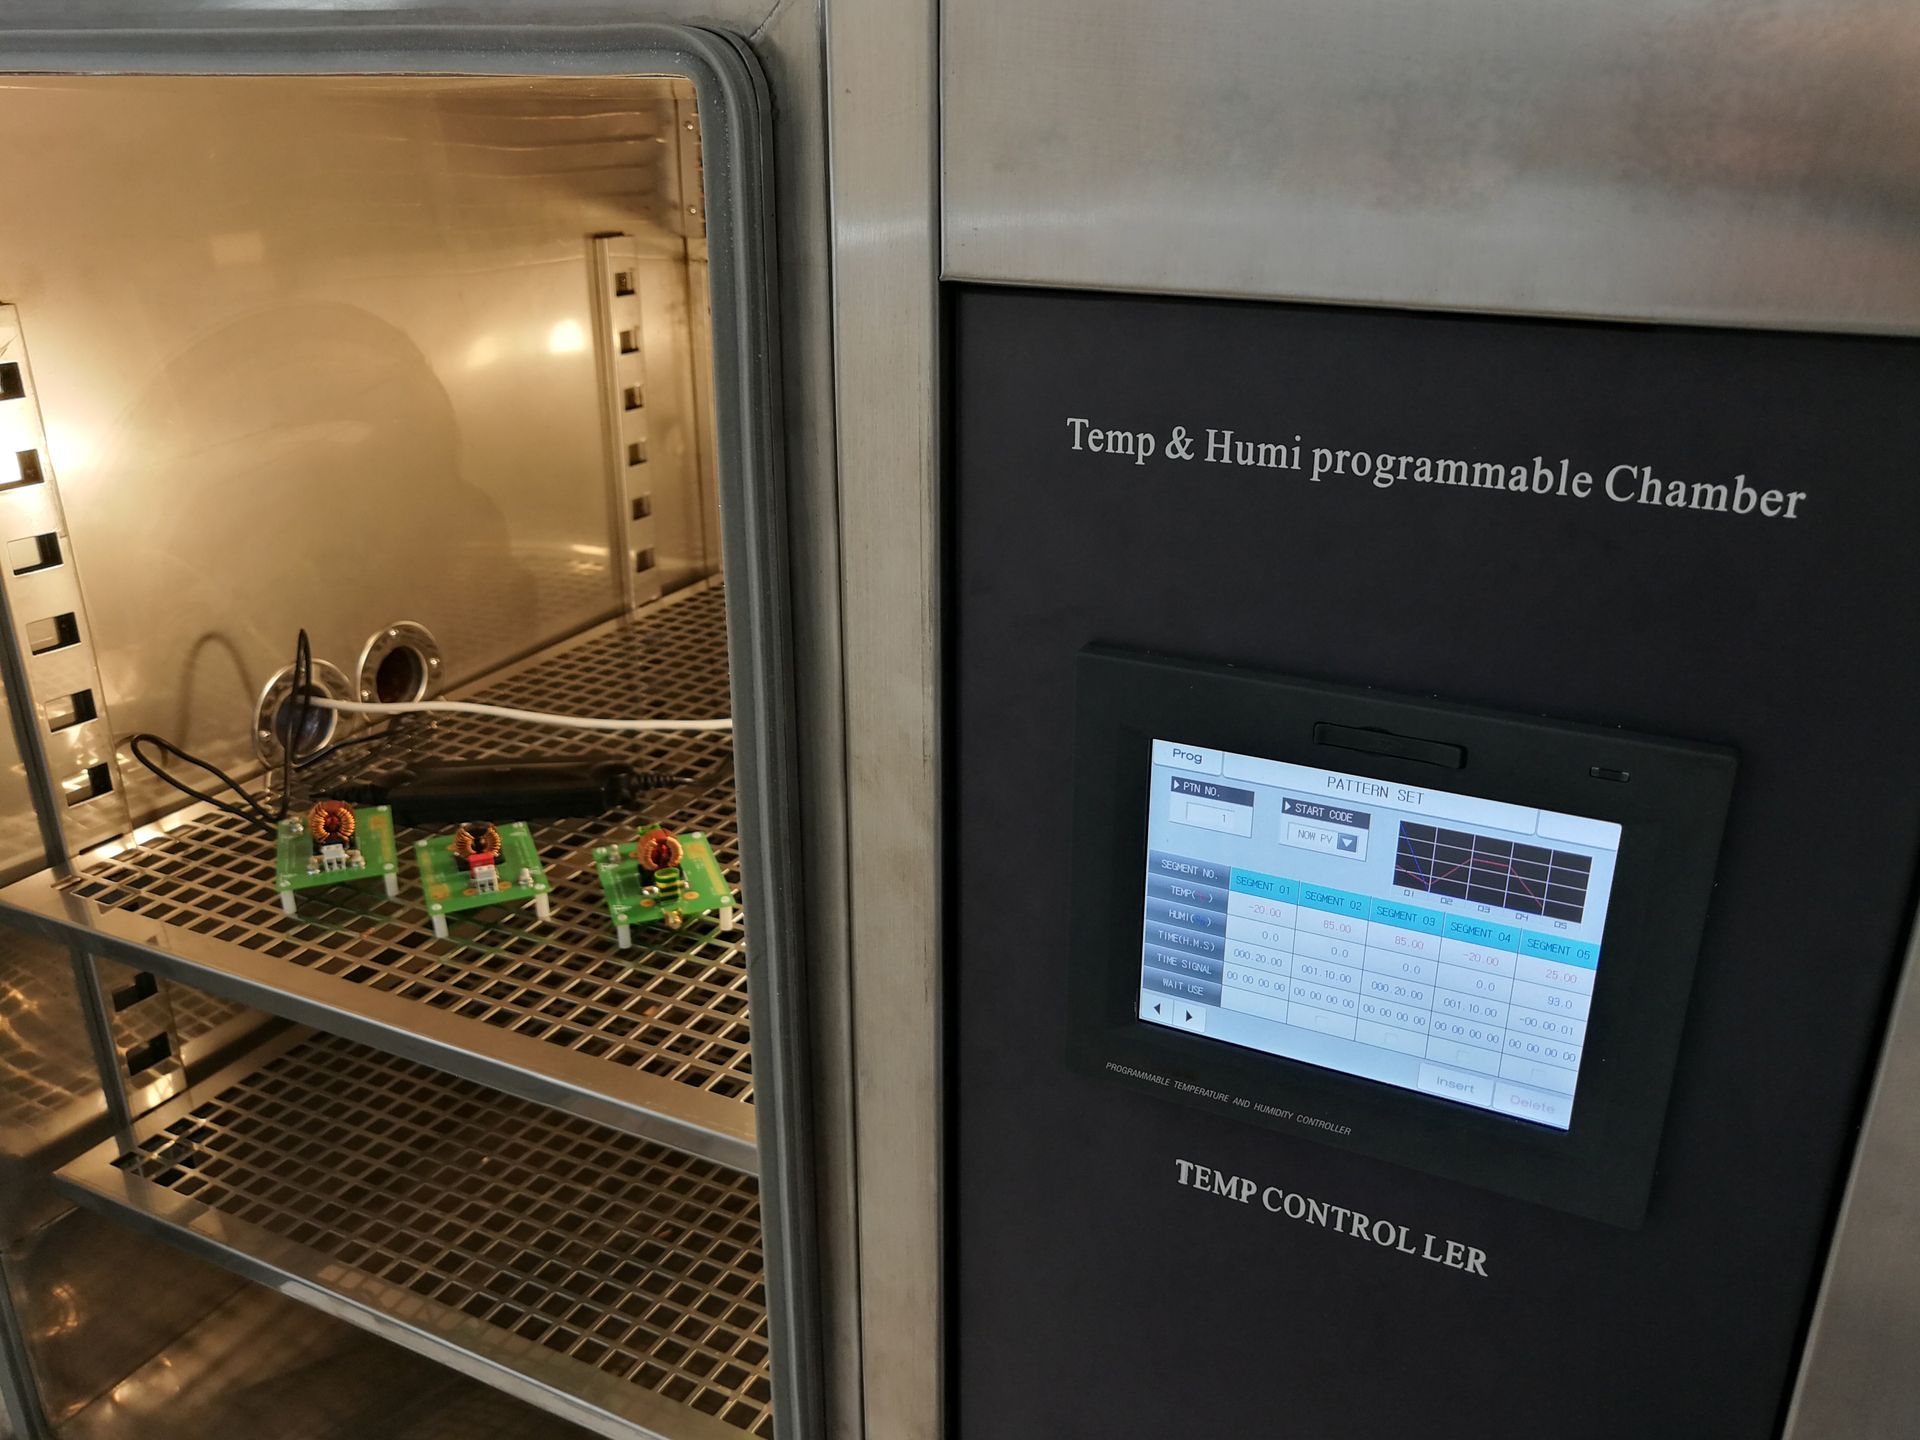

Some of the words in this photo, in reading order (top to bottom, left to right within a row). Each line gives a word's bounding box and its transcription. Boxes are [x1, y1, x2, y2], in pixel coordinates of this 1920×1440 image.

[1066, 417, 1156, 466] Temp
[1165, 425, 1195, 461] &
[1204, 428, 1302, 470] Humi
[1309, 447, 1593, 498] programmable
[1605, 464, 1807, 519] Chamber
[1172, 748, 1202, 764] Prog
[1183, 781, 1200, 793] PTN
[1204, 786, 1220, 798] NO.
[1327, 776, 1389, 799] PATTERN
[1397, 790, 1424, 804] SET
[1295, 803, 1326, 818] START
[1329, 810, 1354, 823] CODE
[1297, 830, 1316, 842] NOW
[1320, 834, 1333, 844] PV
[1161, 860, 1199, 876] SEGMENT
[1202, 868, 1218, 880] NO.
[1236, 875, 1274, 892] SEGMENT
[1278, 884, 1290, 895] 01
[1304, 890, 1345, 908] SEGMENT
[1350, 900, 1362, 911] 02
[1376, 906, 1418, 922] SEGMENT
[1423, 916, 1436, 926] 03
[1158, 930, 1216, 952] TIME(H.M.S)
[1262, 930, 1280, 942] 0.0
[1450, 922, 1494, 938] SEGMENT
[1498, 932, 1512, 943] 04
[1331, 946, 1349, 958] 0.0
[1527, 938, 1572, 956] SEGMENT
[1576, 949, 1590, 960] 05
[1157, 954, 1178, 966] TIME
[1181, 959, 1212, 975] SIGNAL
[1402, 962, 1421, 974] 0.0
[1162, 978, 1184, 990] WAIT
[1188, 984, 1204, 996] USE
[1476, 980, 1496, 992] 0.0
[1548, 996, 1572, 1009] 93.0
[1436, 1076, 1475, 1094] Insert
[1105, 1062, 1172, 1087] PROGRAMMABLE
[1174, 1080, 1230, 1102] TEMPERATURE
[1232, 1096, 1251, 1109] AND
[1254, 1102, 1294, 1120] HUMIDITY
[1296, 1114, 1352, 1136] CONTROLLER
[1510, 1094, 1556, 1114] Delete
[1175, 1159, 1258, 1204] TEMP
